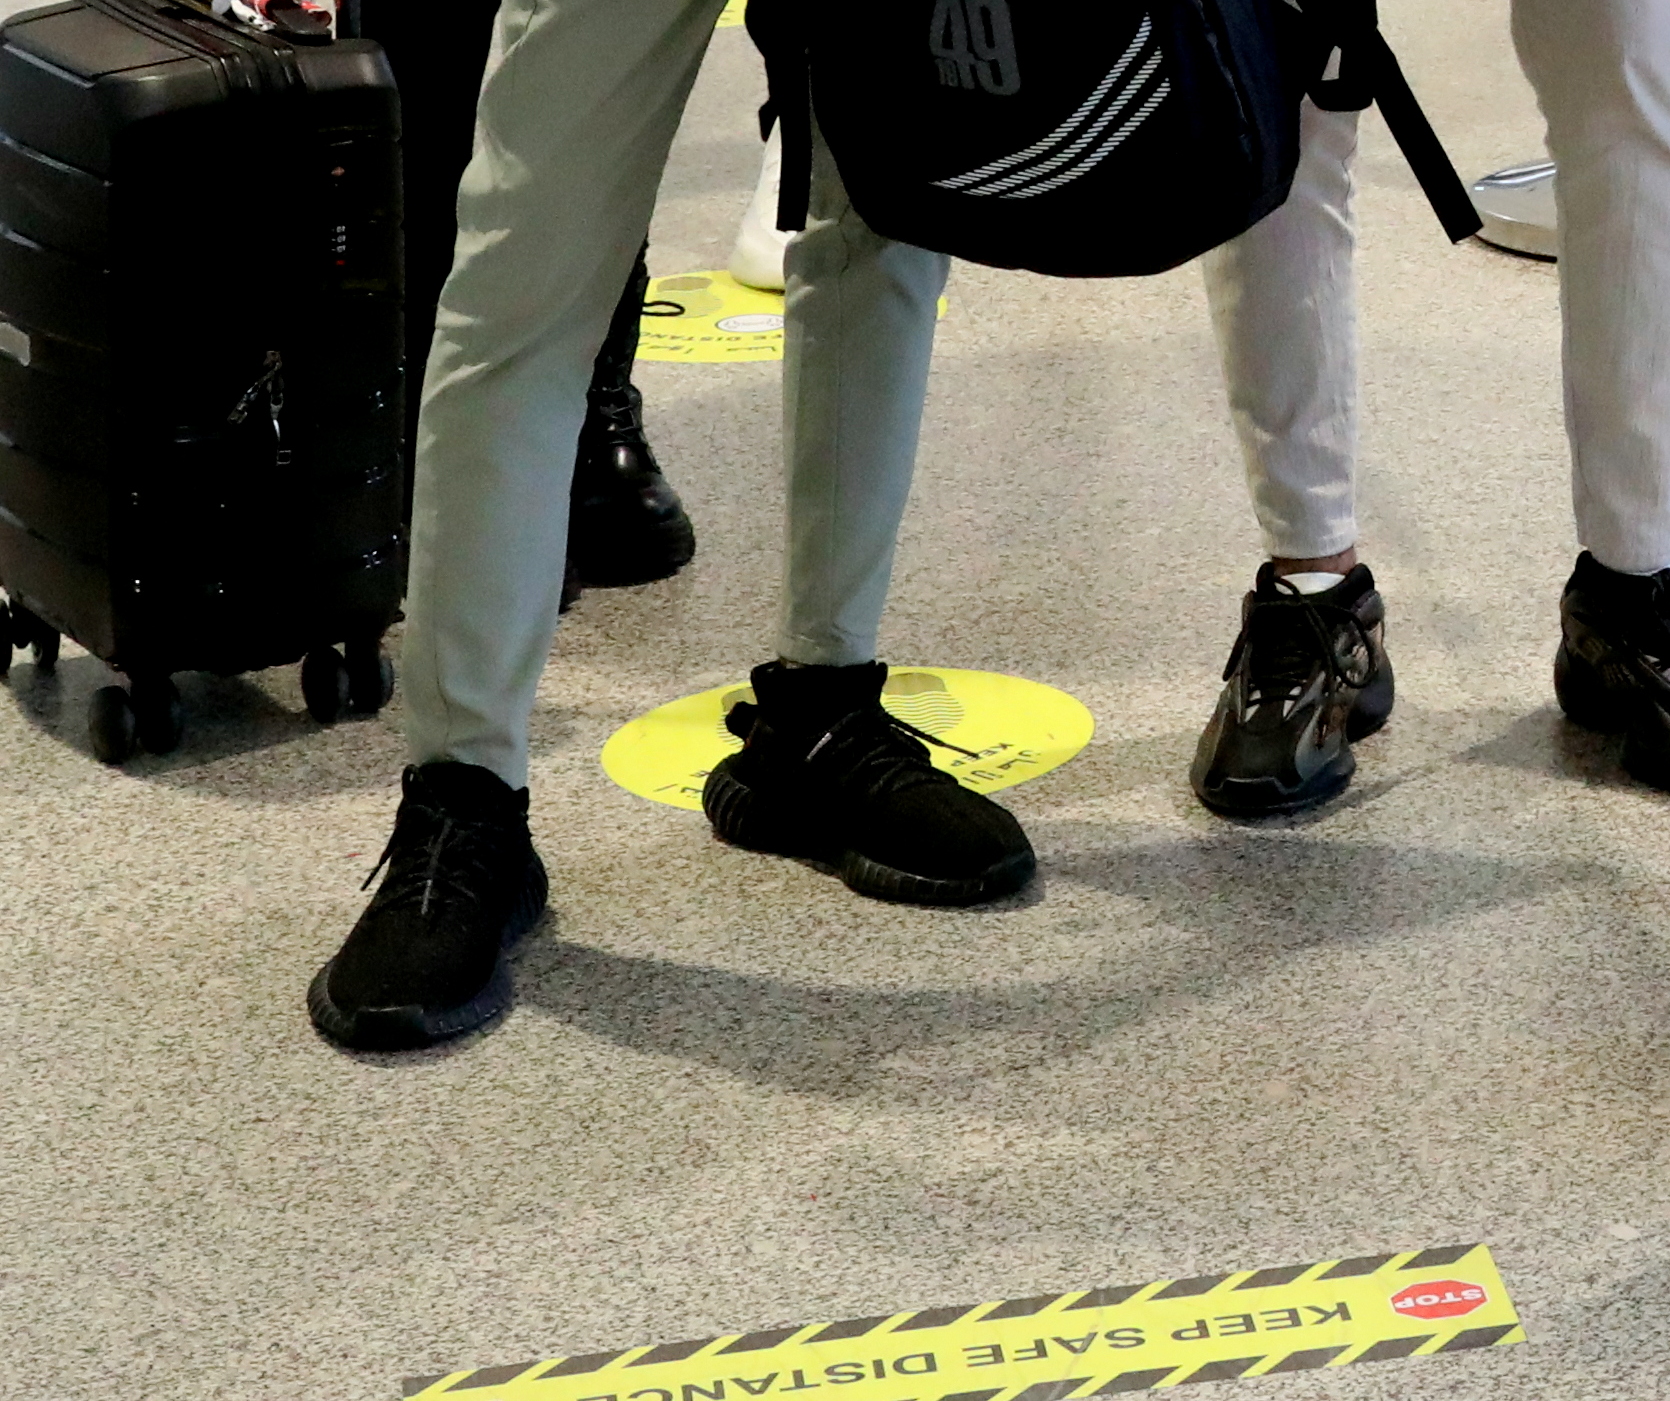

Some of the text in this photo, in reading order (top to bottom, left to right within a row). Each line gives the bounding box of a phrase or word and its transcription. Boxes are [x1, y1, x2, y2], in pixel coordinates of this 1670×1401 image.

[1394, 1286, 1488, 1311] STOP
[1171, 1301, 1352, 1342] KEEP
[961, 1327, 1147, 1368] SAFE
